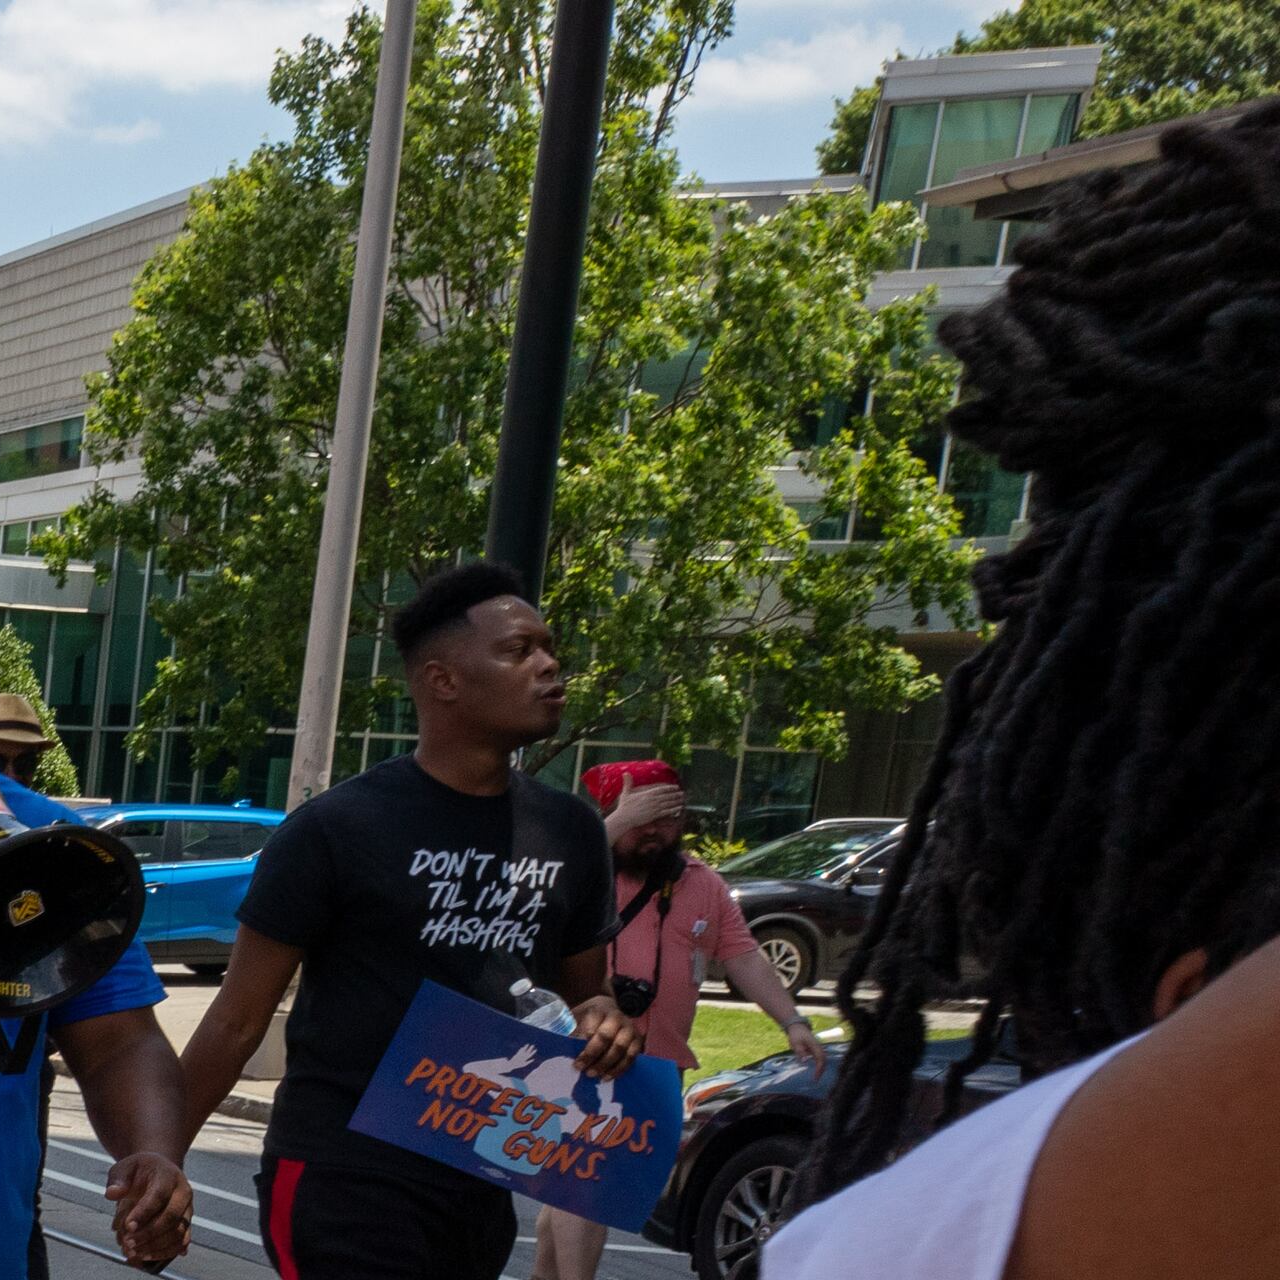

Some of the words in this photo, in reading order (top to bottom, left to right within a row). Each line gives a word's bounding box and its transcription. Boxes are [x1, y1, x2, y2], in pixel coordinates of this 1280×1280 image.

[408, 847, 496, 881] DON'T
[501, 856, 565, 889] WAIT
[428, 880, 468, 910] TIL
[473, 880, 519, 919] I'M
[518, 890, 547, 922] A
[419, 911, 541, 957] HASHTAG
[404, 1057, 567, 1131] PROTECT
[417, 1099, 498, 1142] NOT
[502, 1129, 607, 1180] GUNS.
